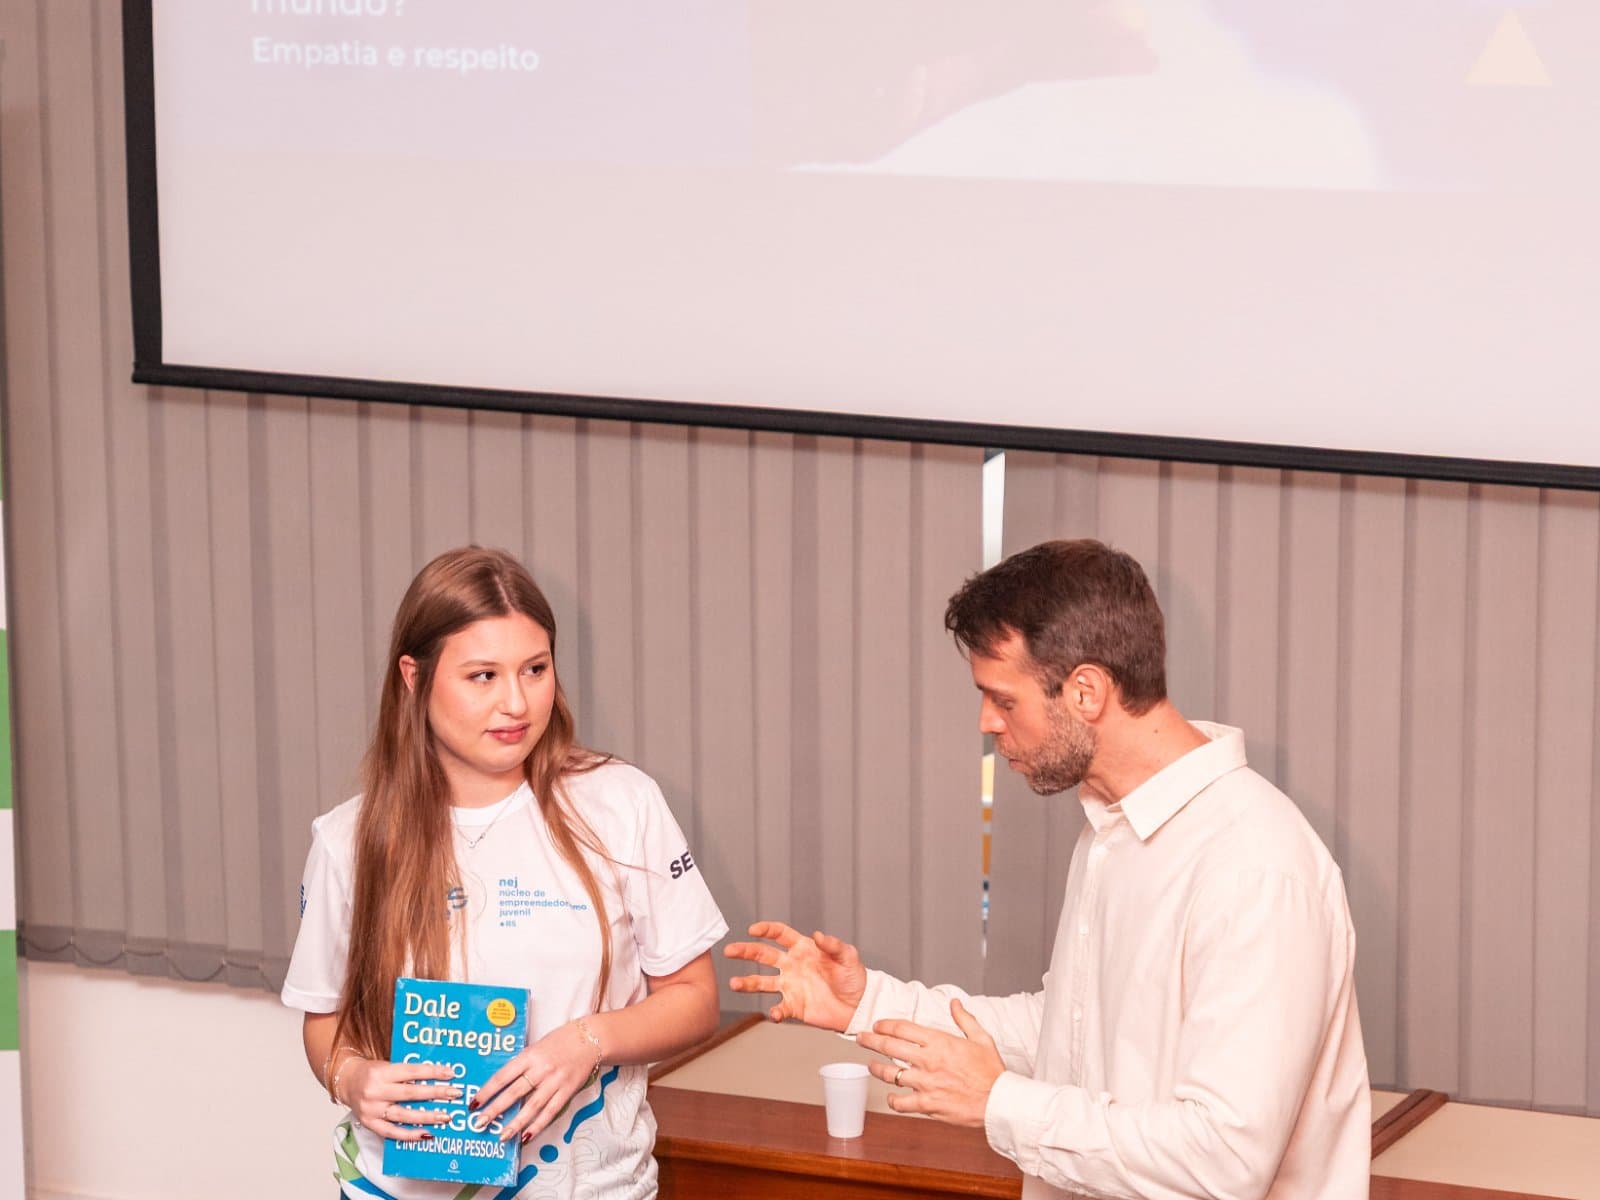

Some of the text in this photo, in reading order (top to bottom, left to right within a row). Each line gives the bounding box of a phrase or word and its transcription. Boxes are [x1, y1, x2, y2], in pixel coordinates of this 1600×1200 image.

[251, 36, 540, 74] Empatia e respeito
[499, 876, 518, 888] nej
[534, 889, 546, 897] de
[499, 908, 531, 918] juvenil
[404, 992, 461, 1019] Dale
[402, 1021, 516, 1056] Carnegie
[464, 1139, 506, 1159] PESSOAS
